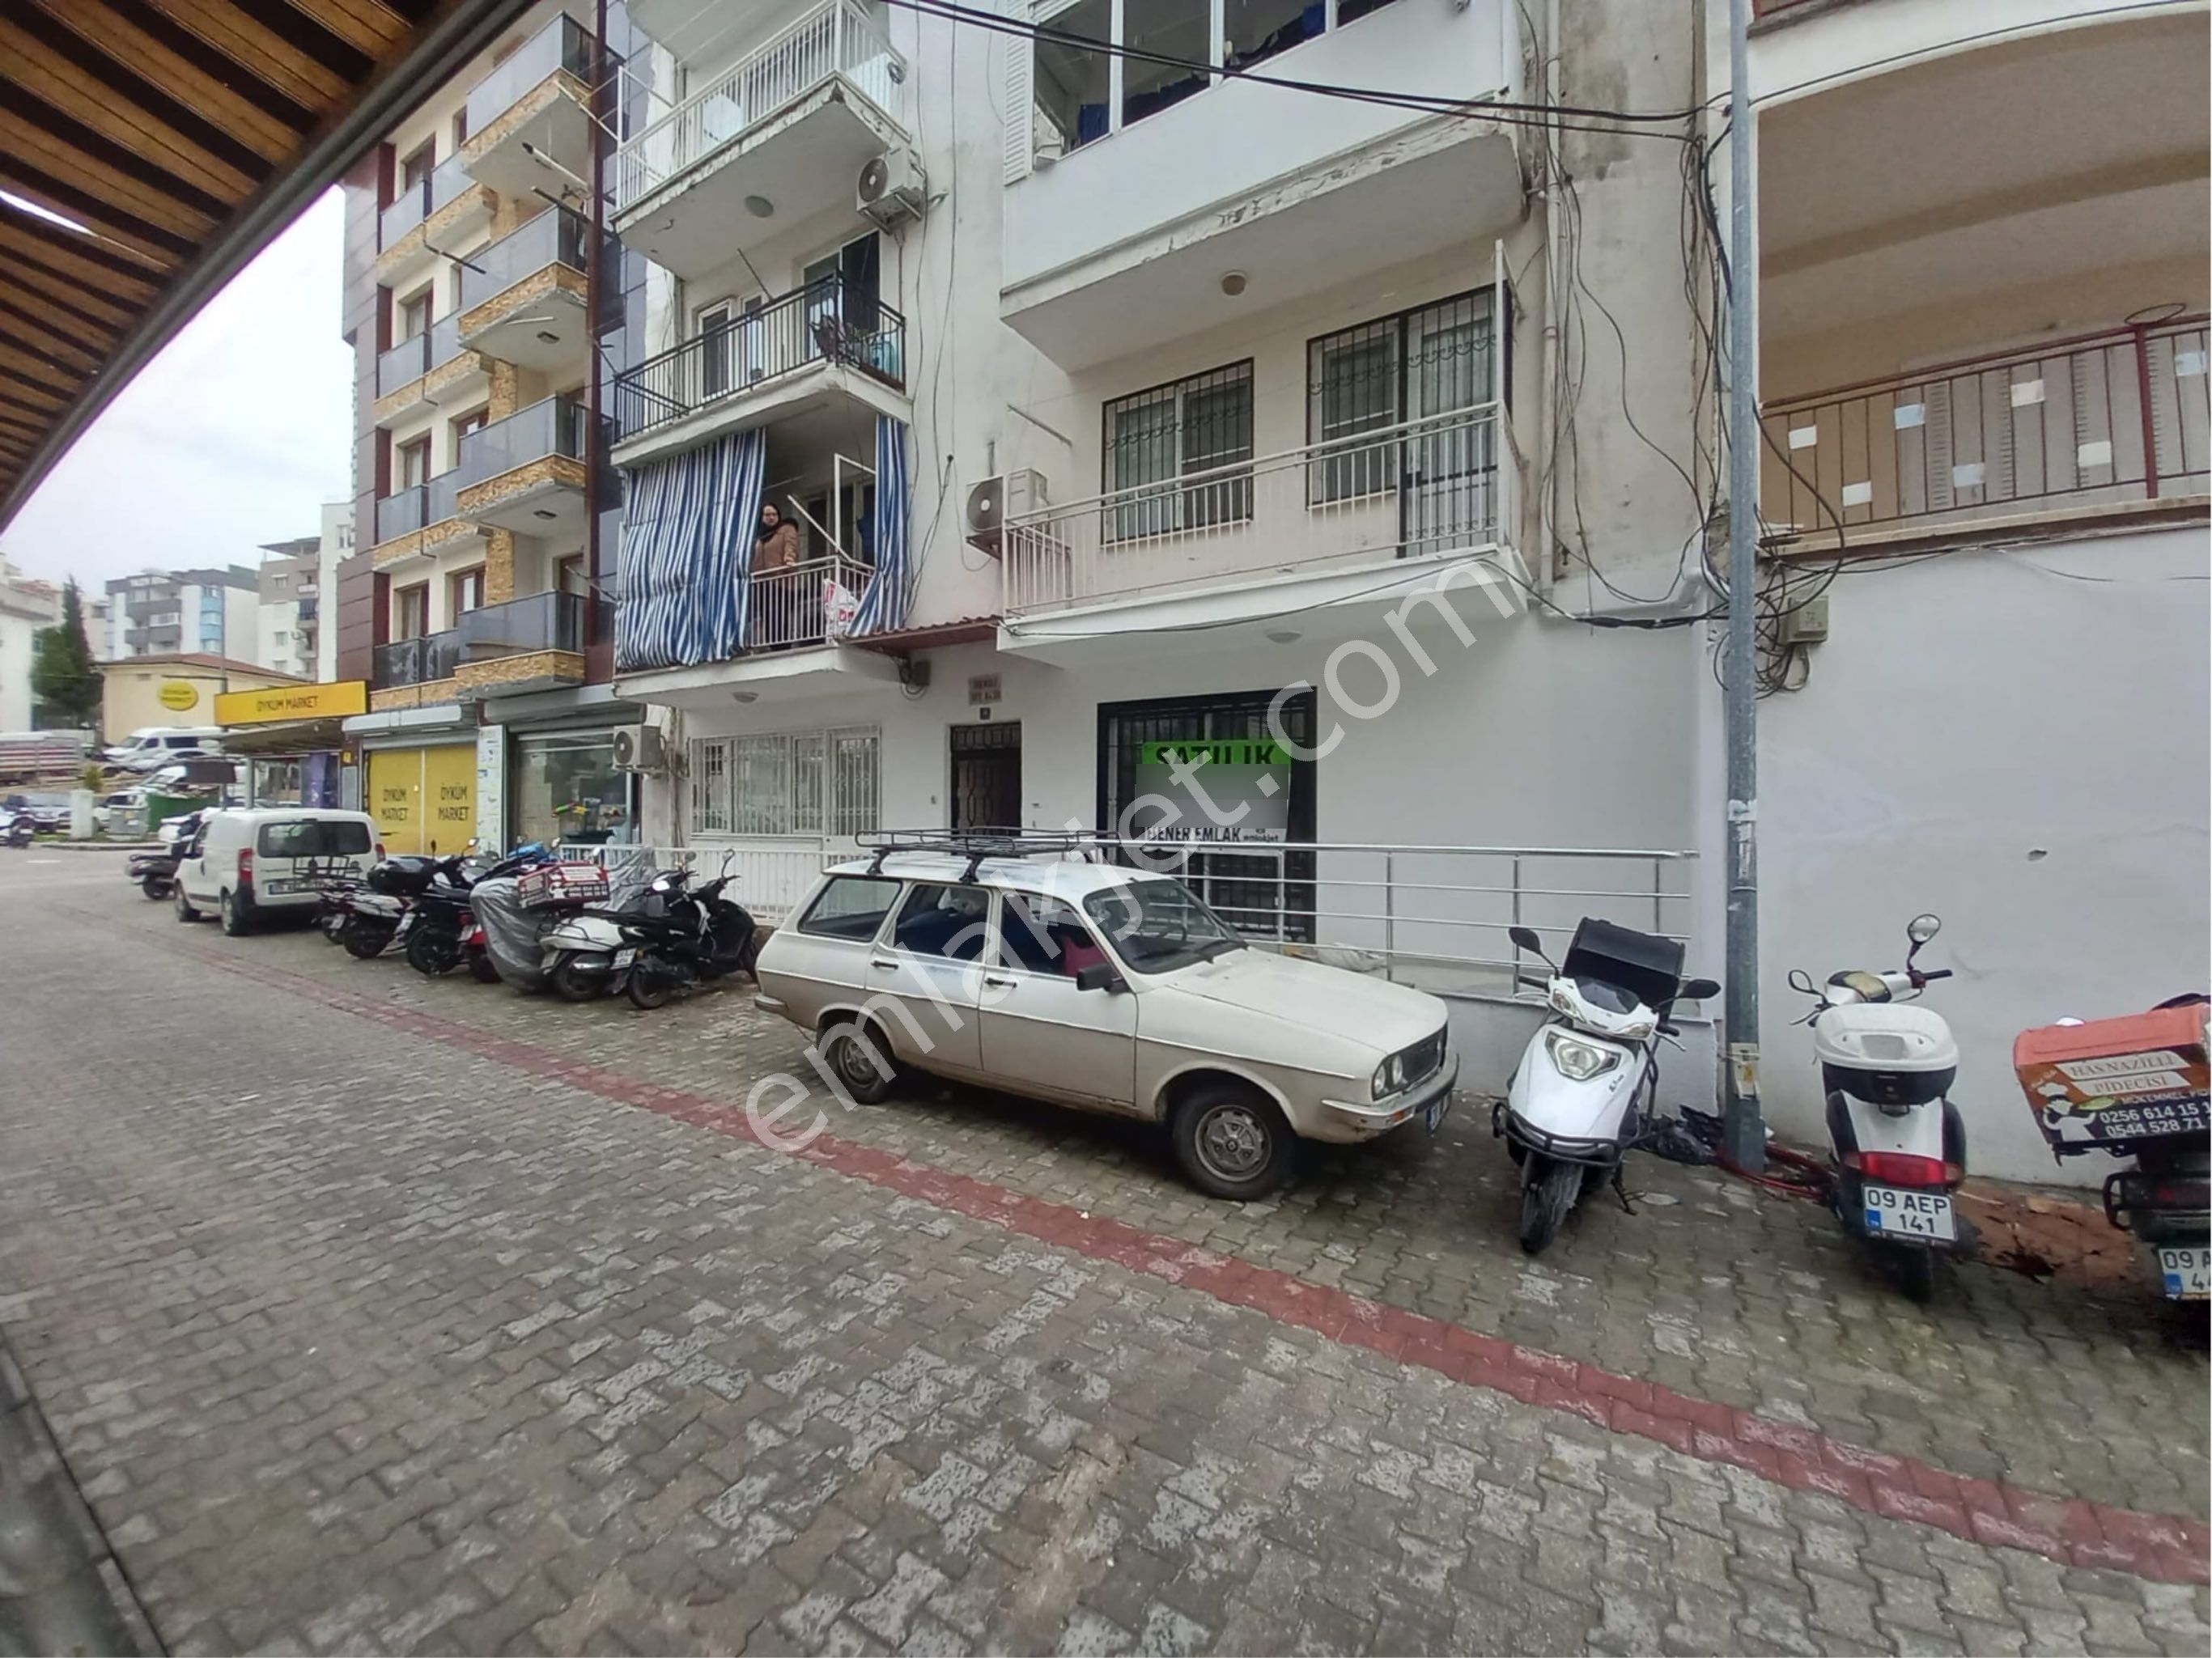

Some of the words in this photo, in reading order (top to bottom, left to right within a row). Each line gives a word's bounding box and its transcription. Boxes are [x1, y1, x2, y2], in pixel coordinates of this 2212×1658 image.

[285, 695, 319, 710] MARKET
[380, 808, 408, 821] MARKET
[438, 807, 469, 821] MARKET
[2099, 1109, 2140, 1123] 0256
[2143, 1105, 2175, 1120] 614
[2177, 1103, 2199, 1116] 15
[2105, 1122, 2146, 1139] 0544
[2148, 1119, 2180, 1133] 528
[2183, 1117, 2206, 1130] 71
[1868, 1189, 1896, 1208] 09
[1904, 1194, 1947, 1215] AEP
[1899, 1214, 1935, 1234] 141
[2163, 1251, 2194, 1270] 09
